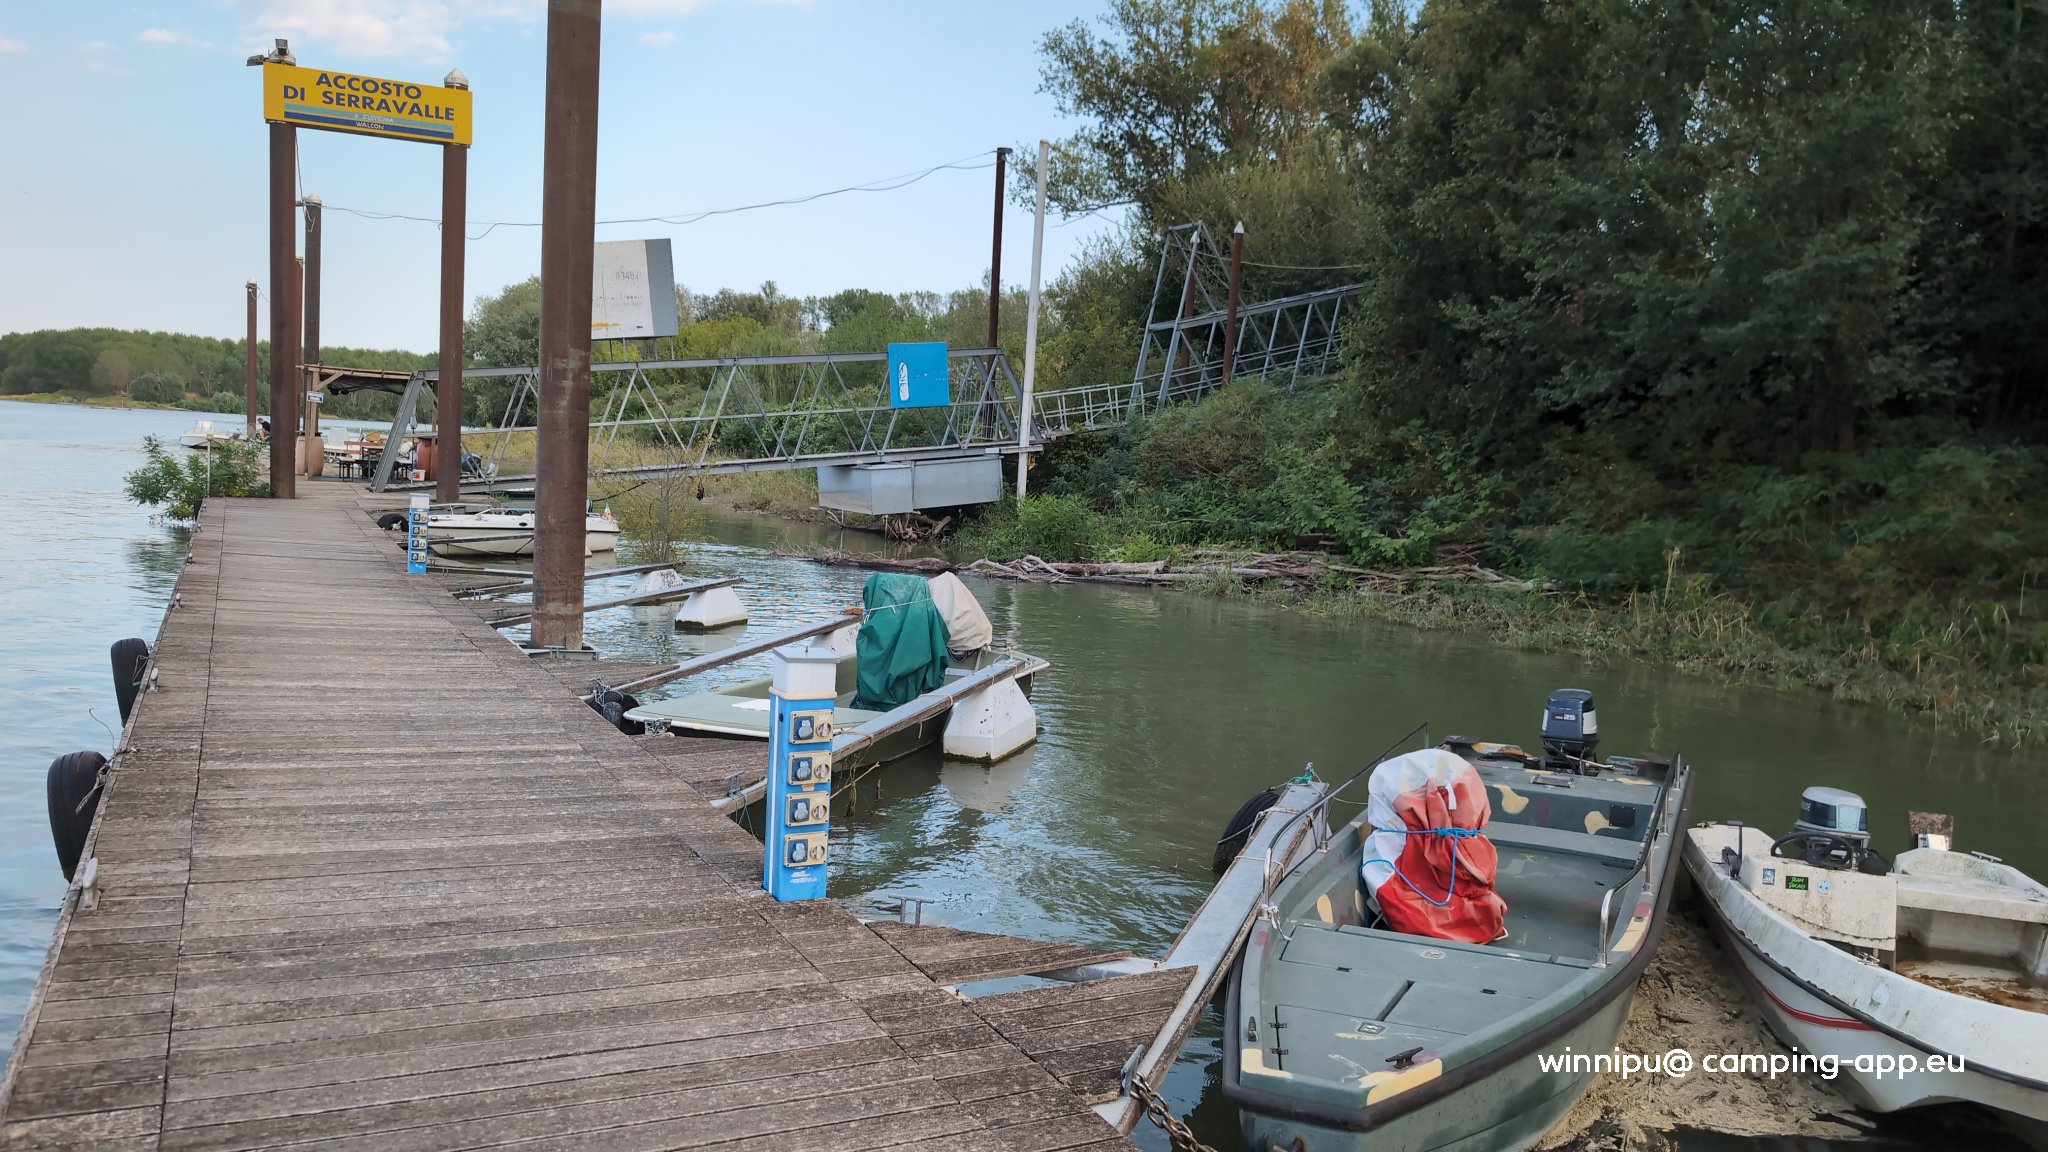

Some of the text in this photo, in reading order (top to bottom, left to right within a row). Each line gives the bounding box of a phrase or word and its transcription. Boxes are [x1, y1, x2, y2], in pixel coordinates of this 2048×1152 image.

[315, 72, 422, 100] ACCOSTO
[283, 85, 455, 121] DI SERRAVALLE
[355, 121, 385, 130] WALCON
